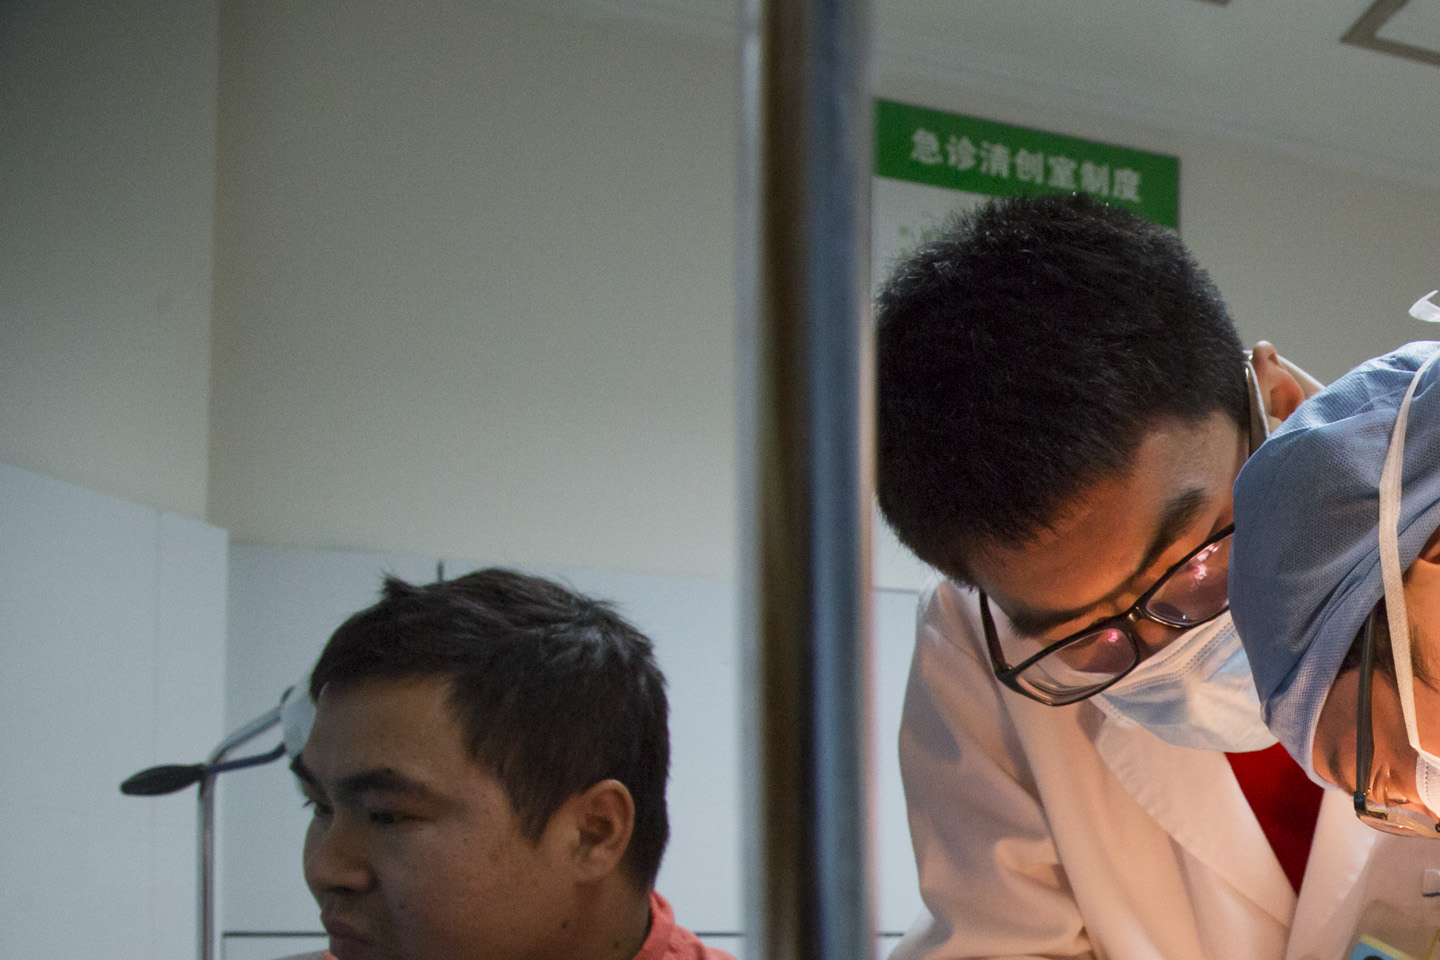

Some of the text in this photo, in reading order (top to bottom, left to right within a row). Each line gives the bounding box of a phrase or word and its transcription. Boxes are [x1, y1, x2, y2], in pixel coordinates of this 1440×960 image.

[909, 128, 1142, 203] 急诊清创室制度
